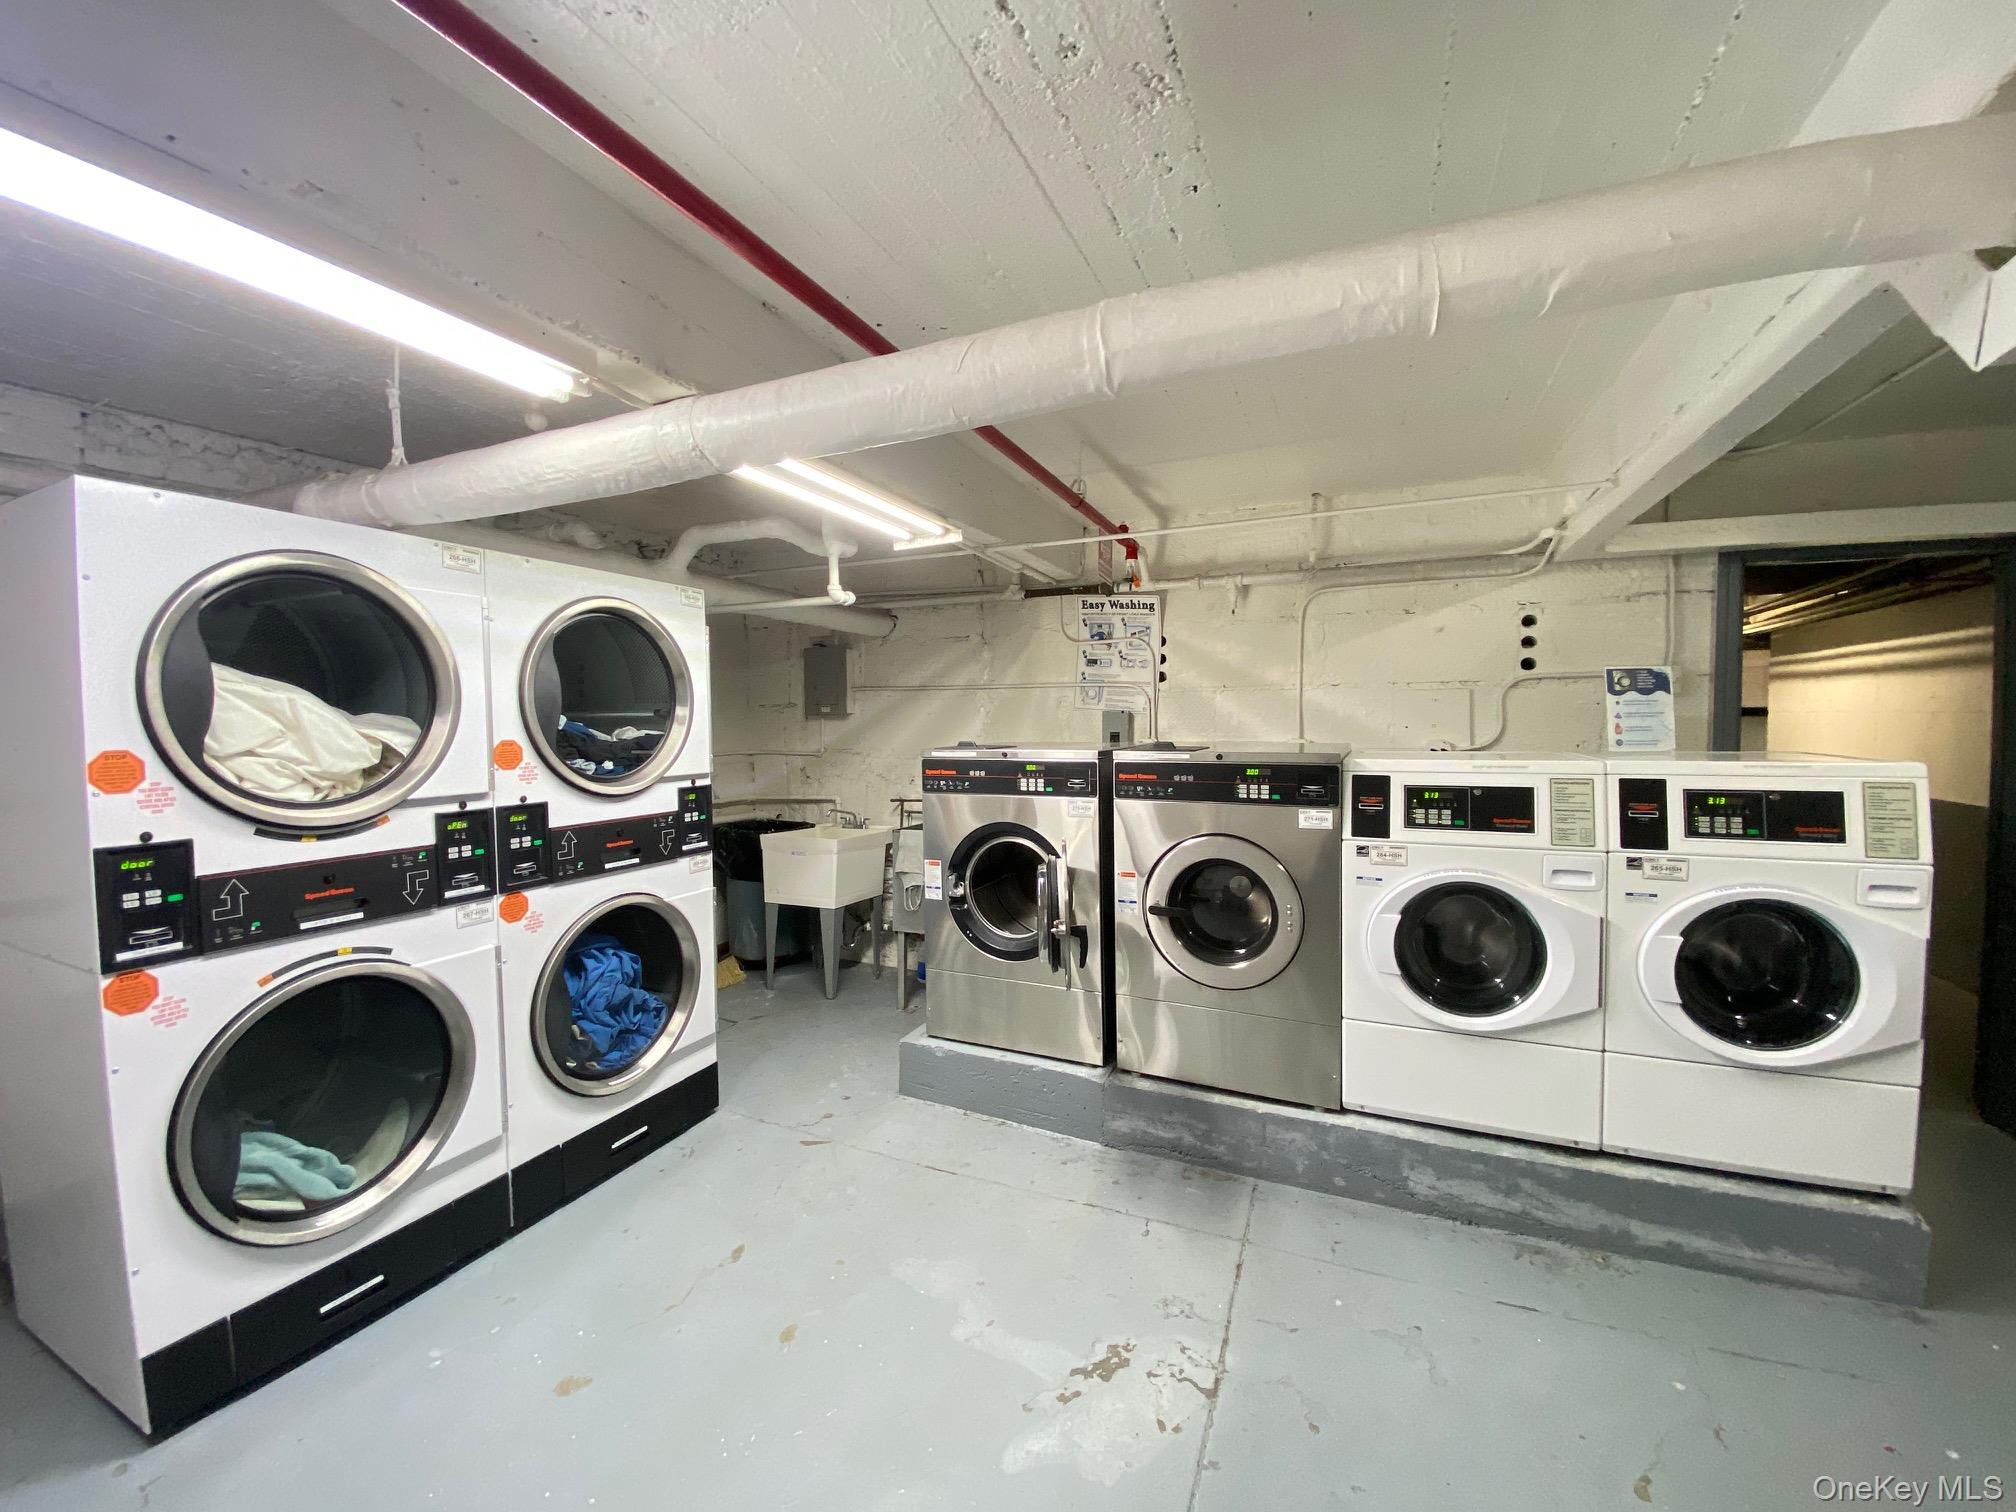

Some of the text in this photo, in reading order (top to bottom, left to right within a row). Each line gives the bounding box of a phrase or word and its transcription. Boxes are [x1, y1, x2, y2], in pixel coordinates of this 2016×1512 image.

[1081, 599, 1156, 612] Easy Washing
[120, 860, 153, 870] door
